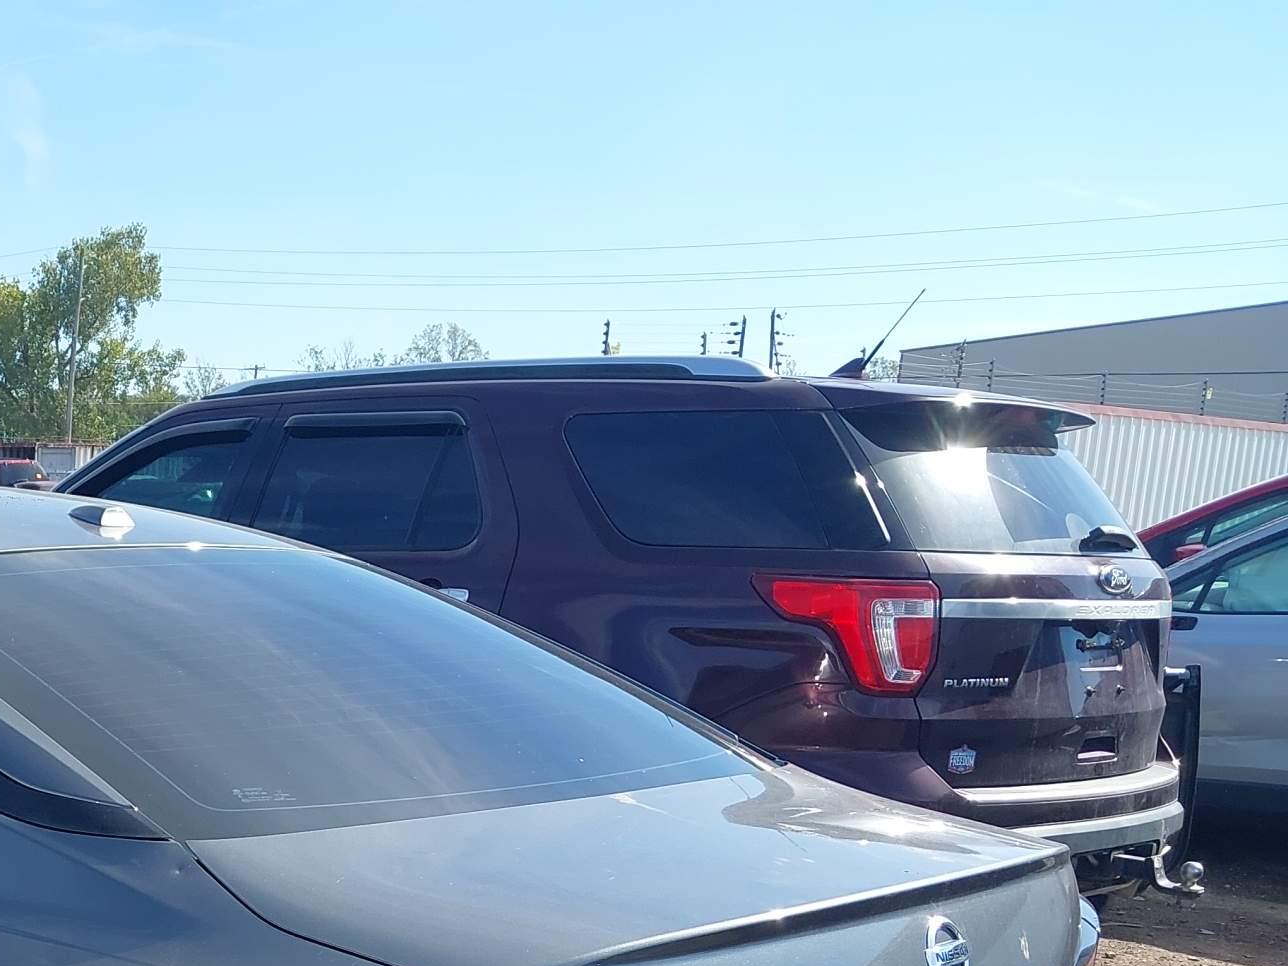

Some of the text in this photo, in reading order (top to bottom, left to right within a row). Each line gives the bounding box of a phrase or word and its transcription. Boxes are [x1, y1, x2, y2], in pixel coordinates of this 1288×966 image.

[1075, 604, 1158, 617] EXPLORER
[943, 677, 1009, 688] PLATINUM
[951, 755, 975, 768] FREEDOM
[935, 942, 969, 963] NISSAN
